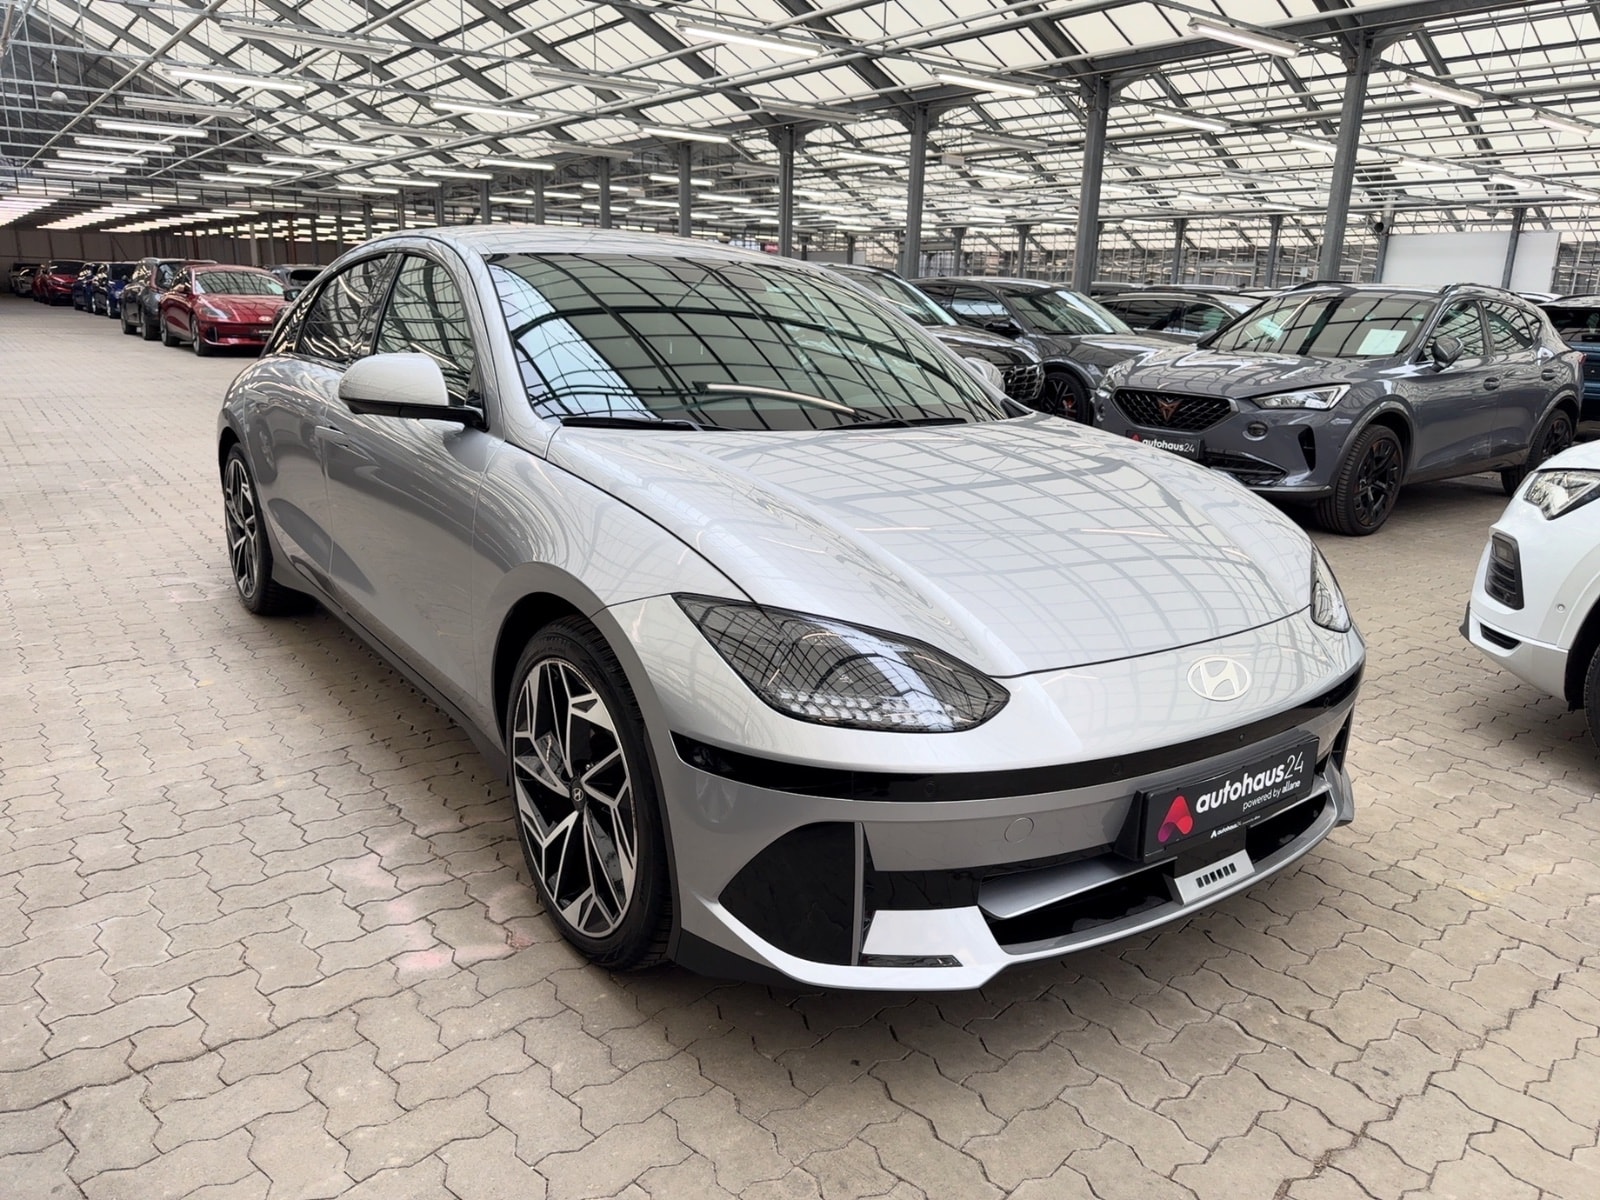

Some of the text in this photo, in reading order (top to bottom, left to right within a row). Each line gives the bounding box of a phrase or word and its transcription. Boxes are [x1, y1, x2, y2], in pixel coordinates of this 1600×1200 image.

[1142, 438, 1195, 453] autohaus24
[1195, 751, 1304, 813] autohaus24
[1243, 789, 1272, 812] powered
[1273, 788, 1281, 798] by
